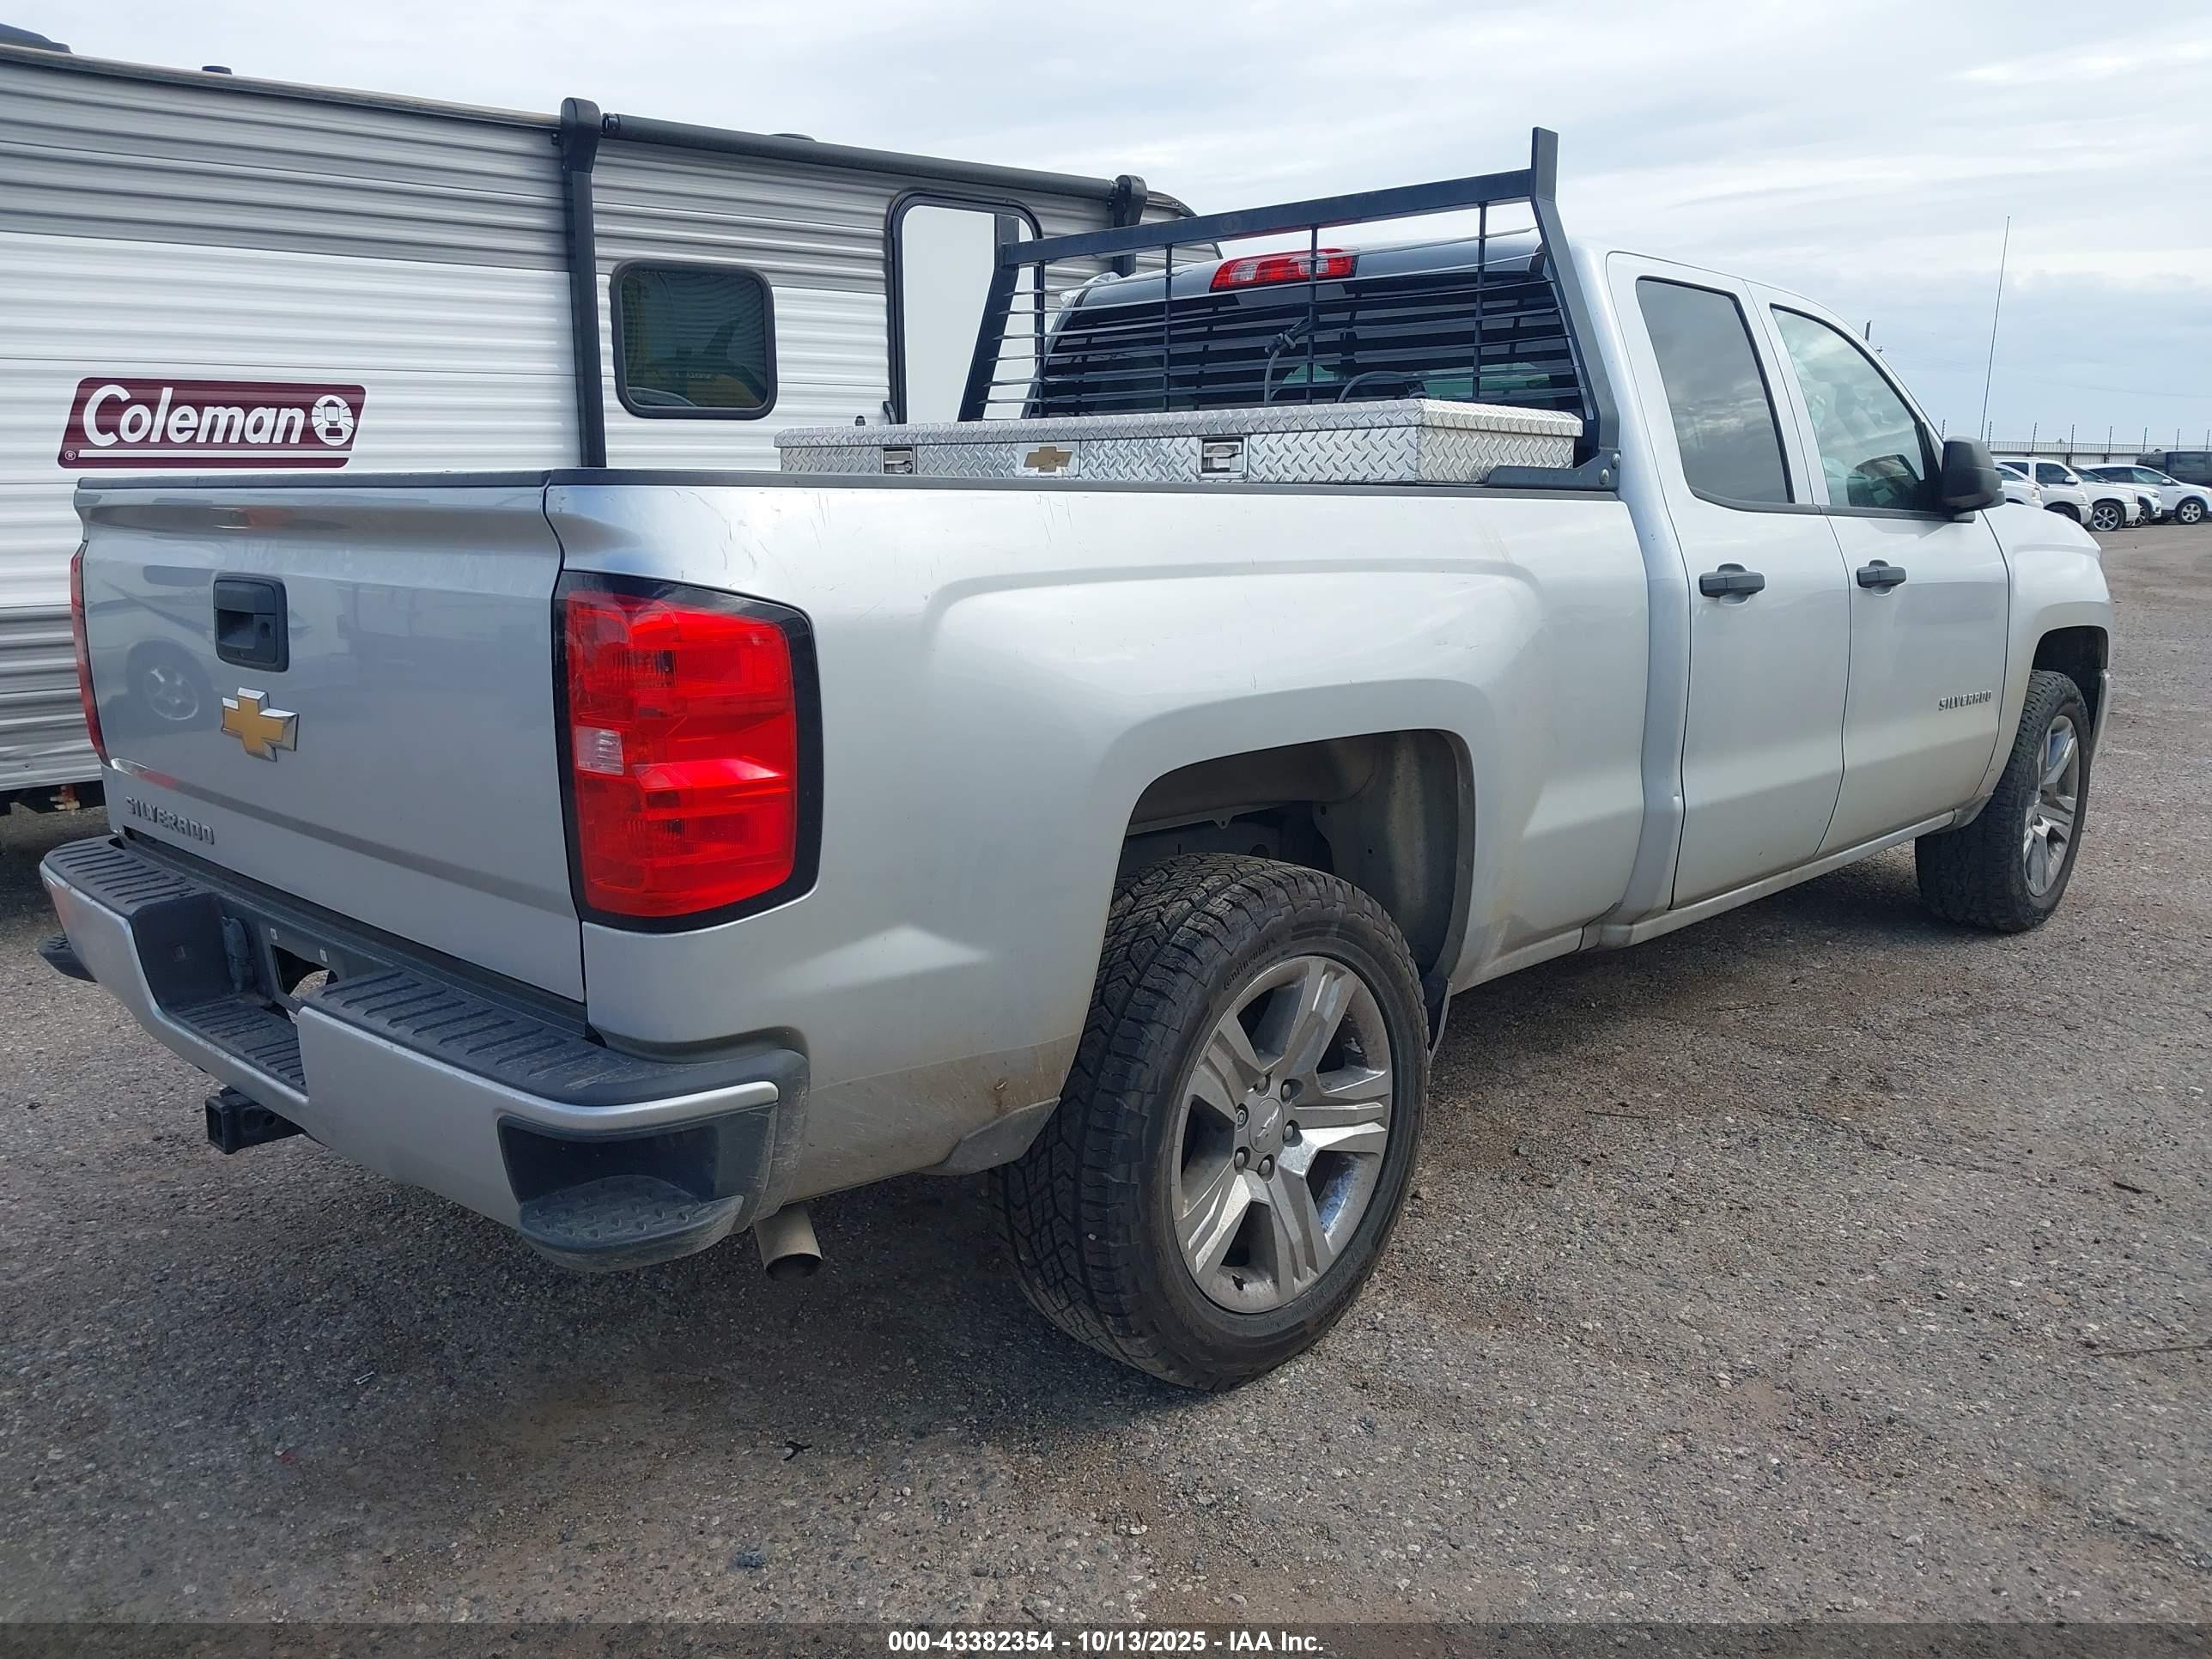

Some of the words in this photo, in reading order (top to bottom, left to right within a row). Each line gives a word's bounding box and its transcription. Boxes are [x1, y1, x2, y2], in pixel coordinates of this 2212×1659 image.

[82, 384, 306, 447] Coleman
[1938, 690, 1993, 712] SILVERADO
[125, 796, 216, 846] SILVERADO
[1224, 940, 1269, 990] Continental
